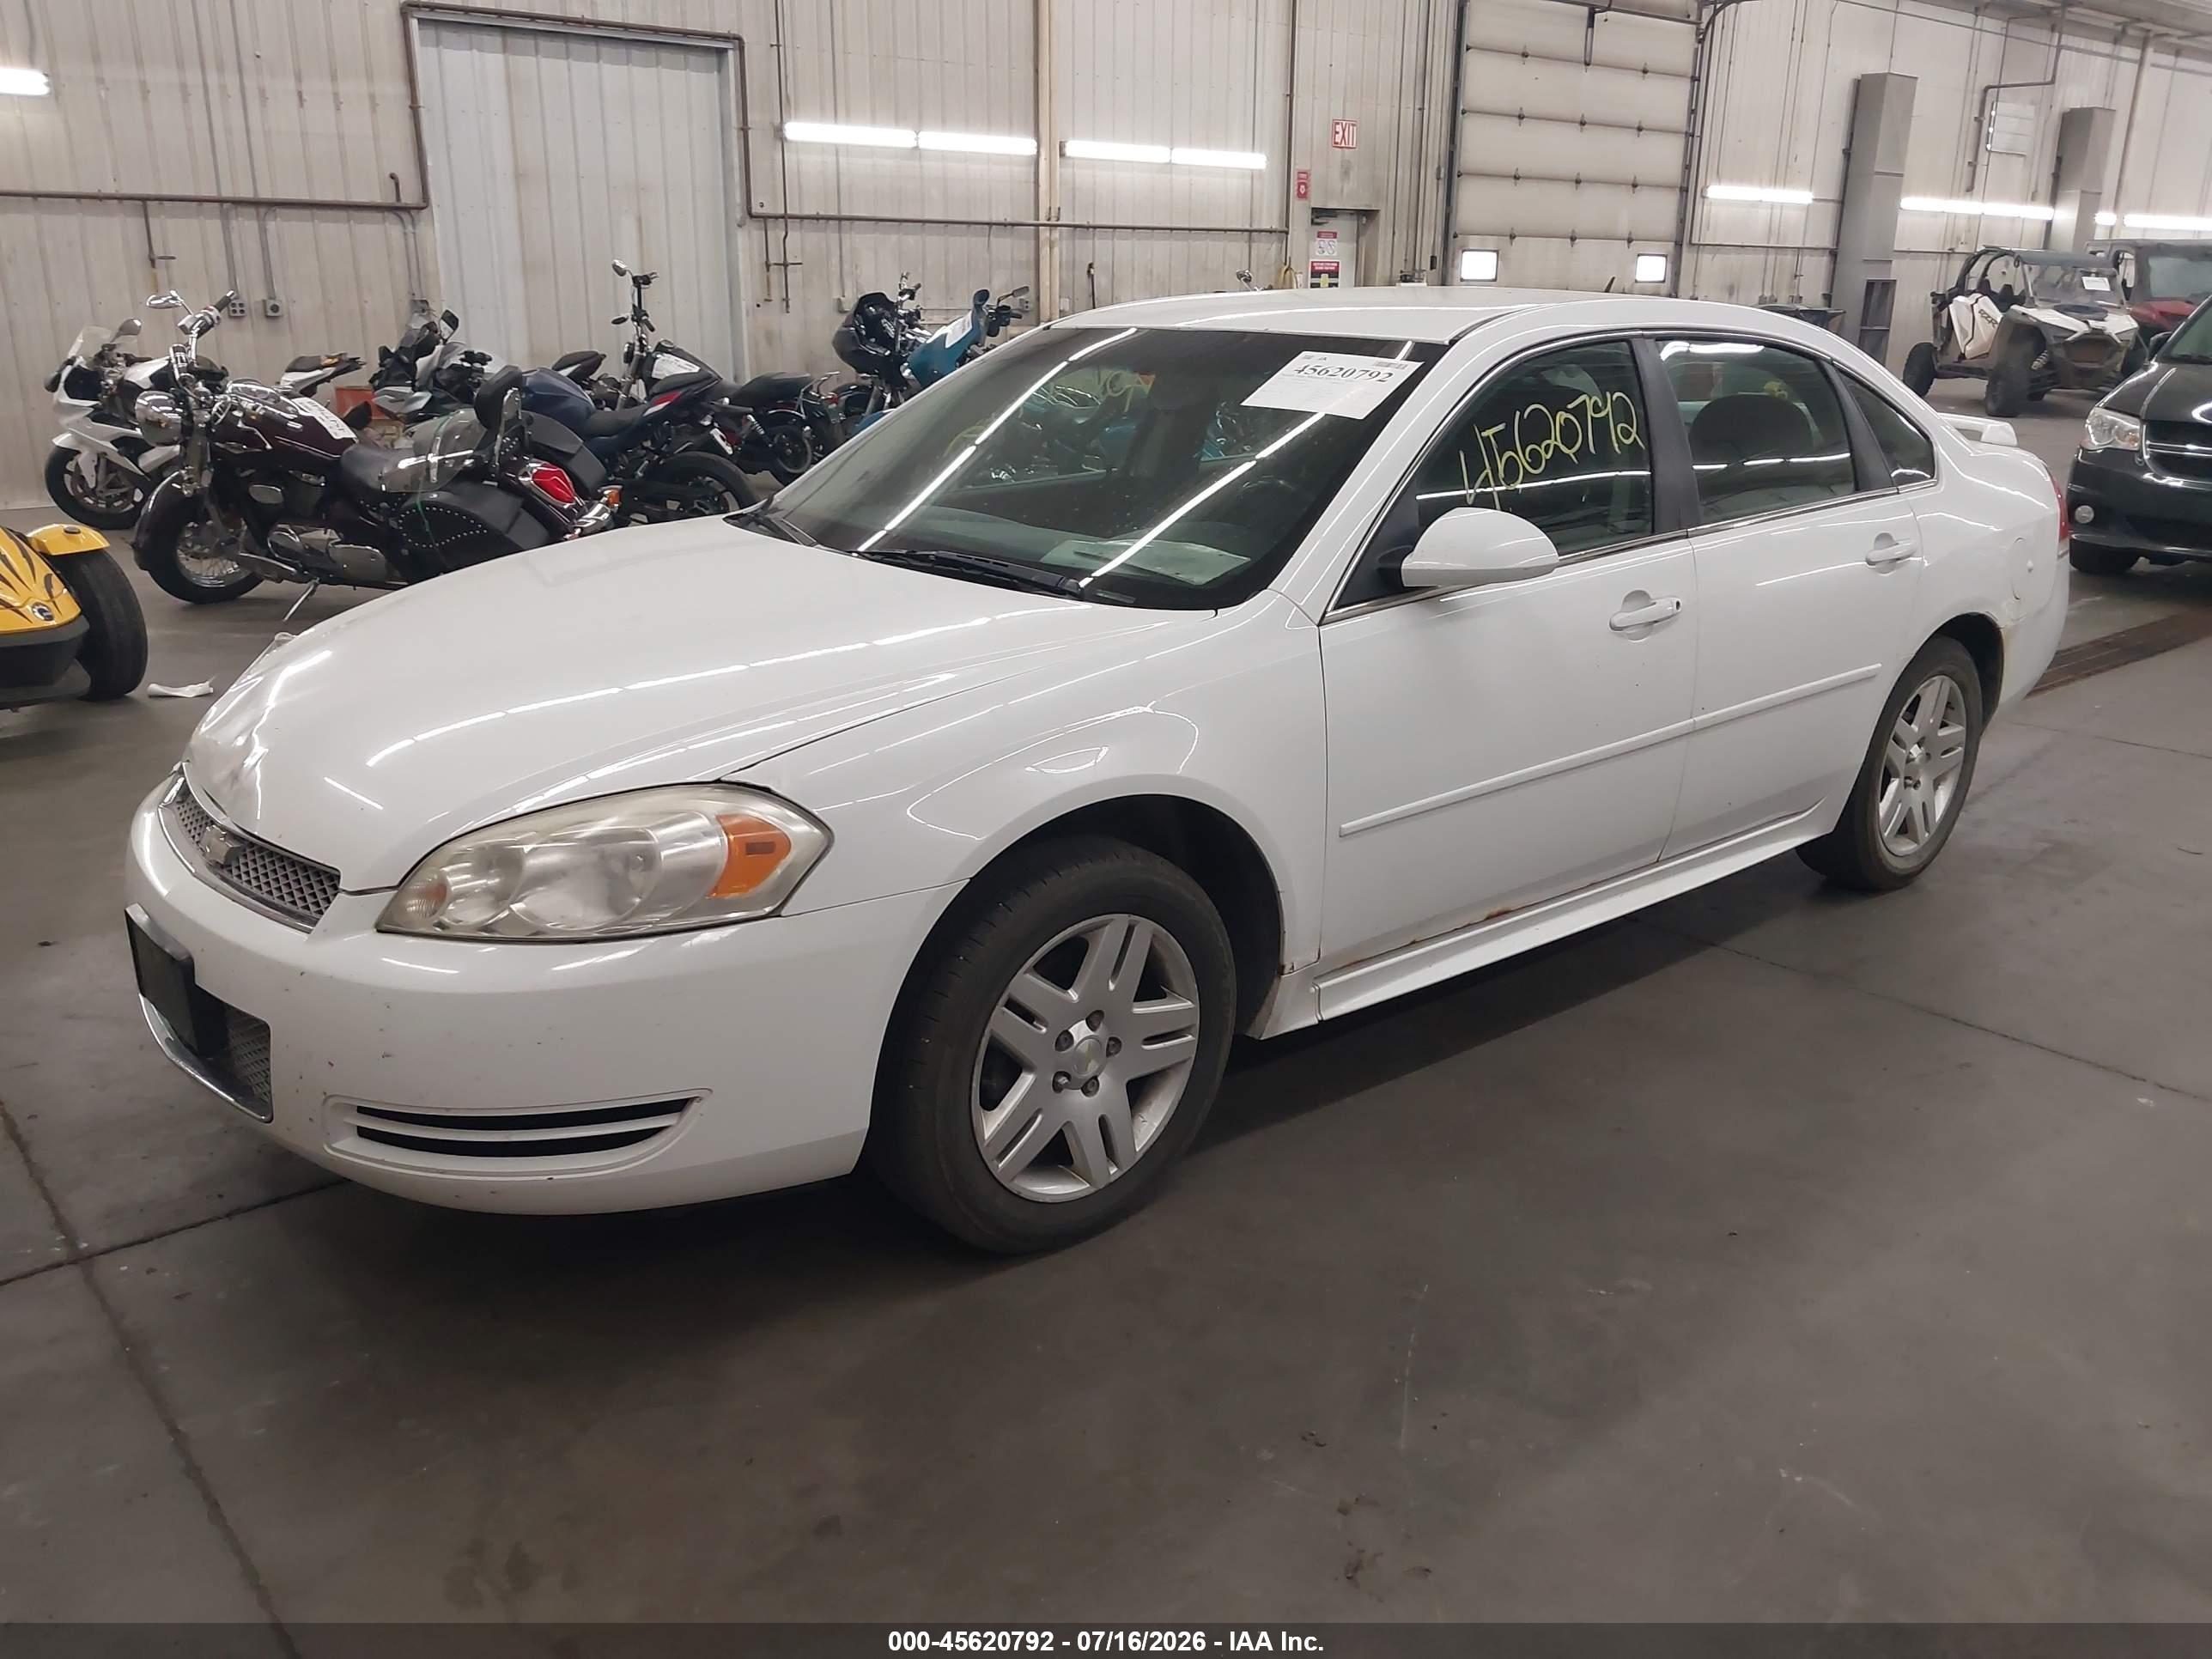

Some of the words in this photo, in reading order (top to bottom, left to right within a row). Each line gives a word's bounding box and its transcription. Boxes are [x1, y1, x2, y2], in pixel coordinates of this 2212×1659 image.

[1334, 122, 1357, 146] EXIT
[1294, 363, 1395, 383] 45620792
[1459, 391, 1646, 511] 45620792
